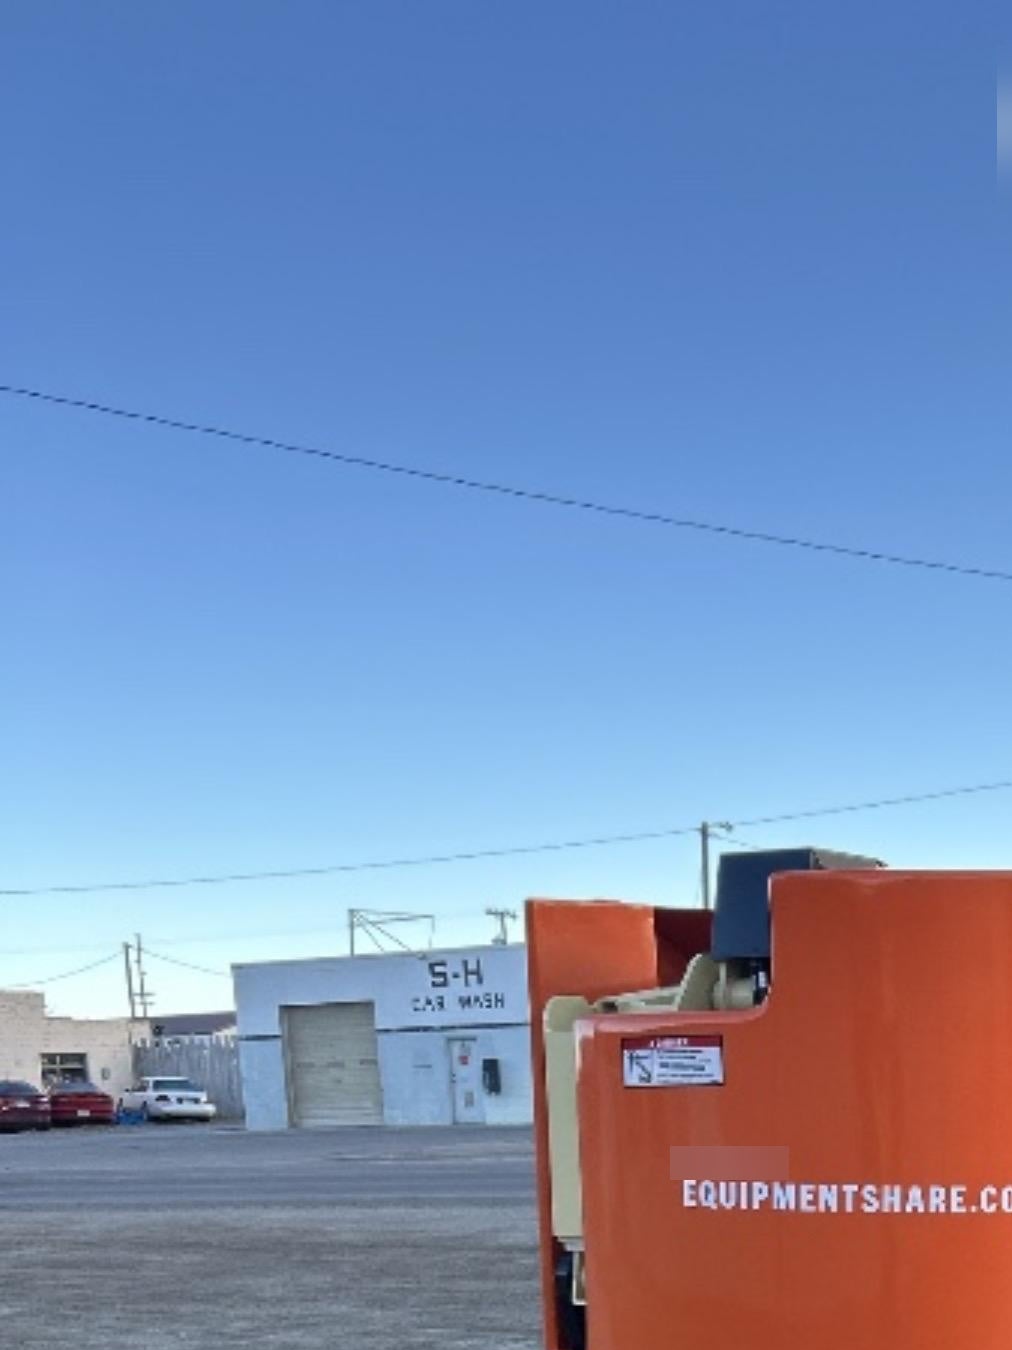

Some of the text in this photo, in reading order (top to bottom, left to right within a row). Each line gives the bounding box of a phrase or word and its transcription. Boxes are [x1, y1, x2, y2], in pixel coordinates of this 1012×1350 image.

[428, 957, 484, 988] S-H
[411, 992, 505, 1012] CAR WASH
